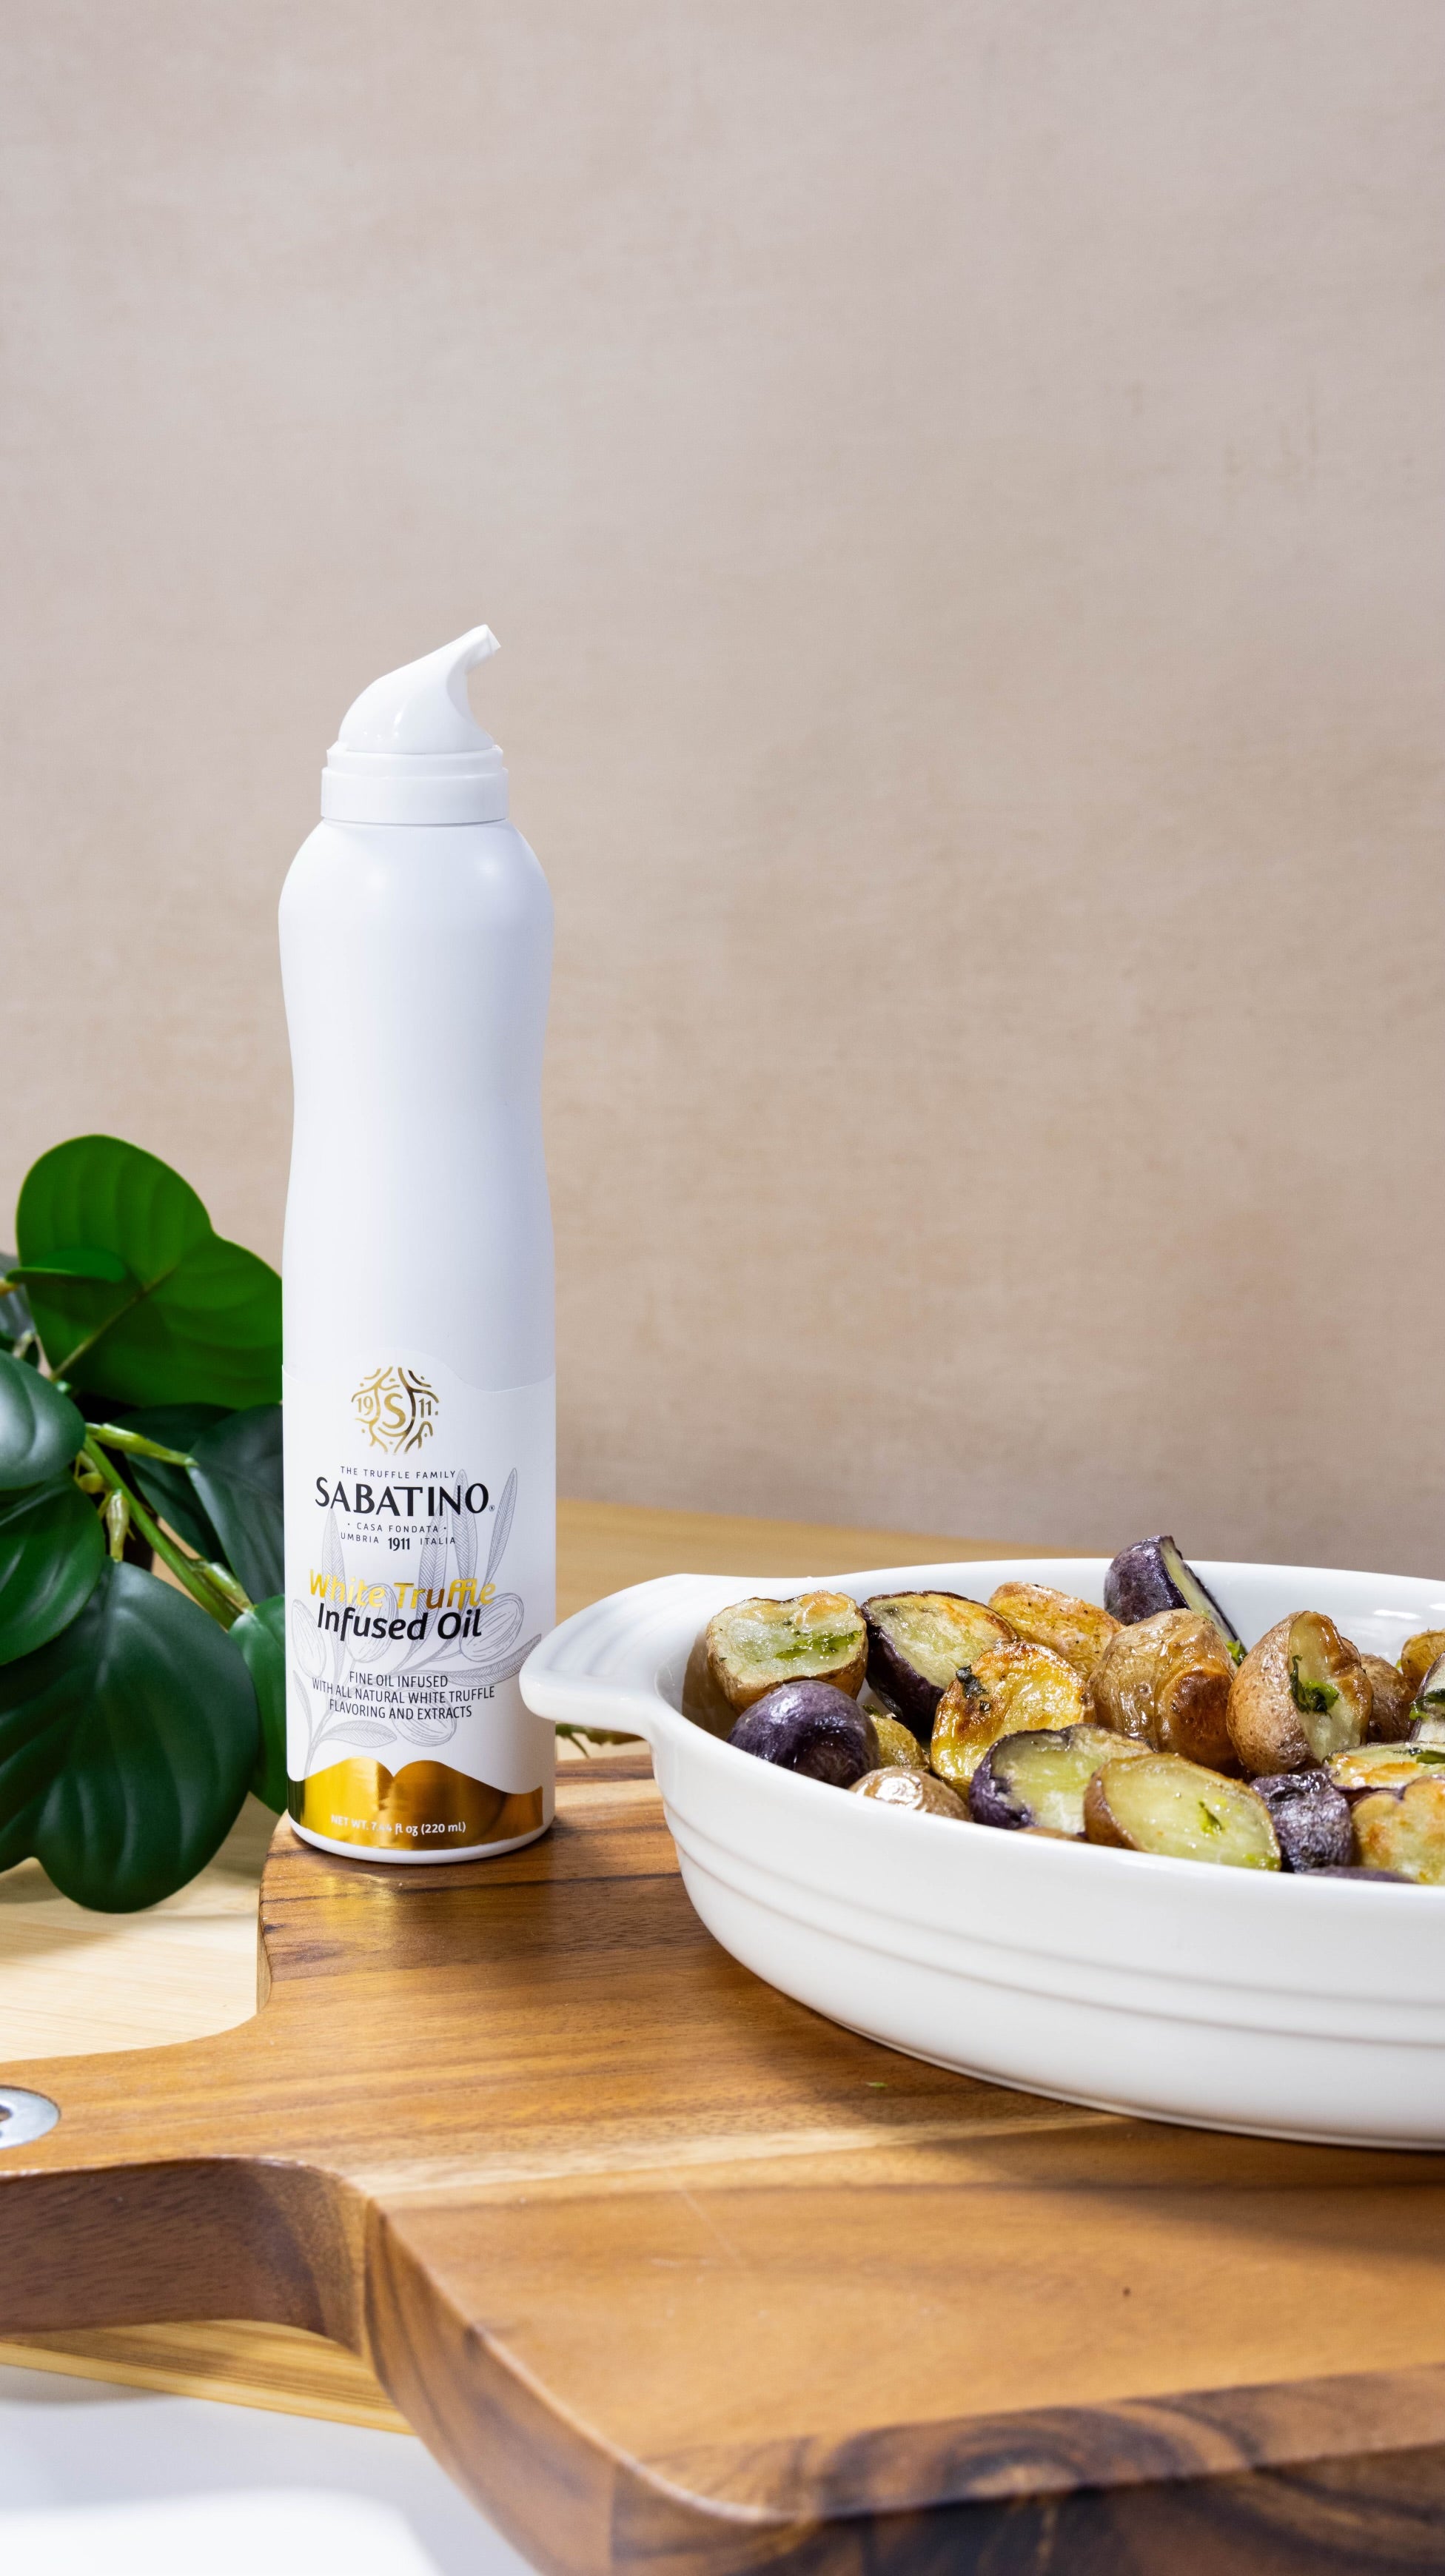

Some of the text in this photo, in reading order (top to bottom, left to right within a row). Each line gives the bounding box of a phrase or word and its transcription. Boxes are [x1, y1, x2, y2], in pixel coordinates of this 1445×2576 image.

[383, 1392, 406, 1429] S
[341, 1466, 456, 1479] THE TRUFFLE FAMILY
[357, 1522, 438, 1533] CASA FONDATA
[341, 1532, 455, 1551] UMBRIA 1911 ITALIA
[309, 1569, 496, 1610] White Truffle
[318, 1603, 482, 1641] Infused Oil
[349, 1671, 448, 1688] FINE OIL INFUSED
[312, 1677, 495, 1704] WITH ALL NATURAL WHITE TRUFFLE
[329, 1699, 472, 1720] FLAVORING AND EXTRACTS
[331, 1814, 349, 1826] NET
[351, 1820, 369, 1831] WT.
[395, 1823, 403, 1834] fl
[406, 1825, 418, 1836] oz
[421, 1823, 445, 1834] (220
[448, 1821, 467, 1834] ml)
